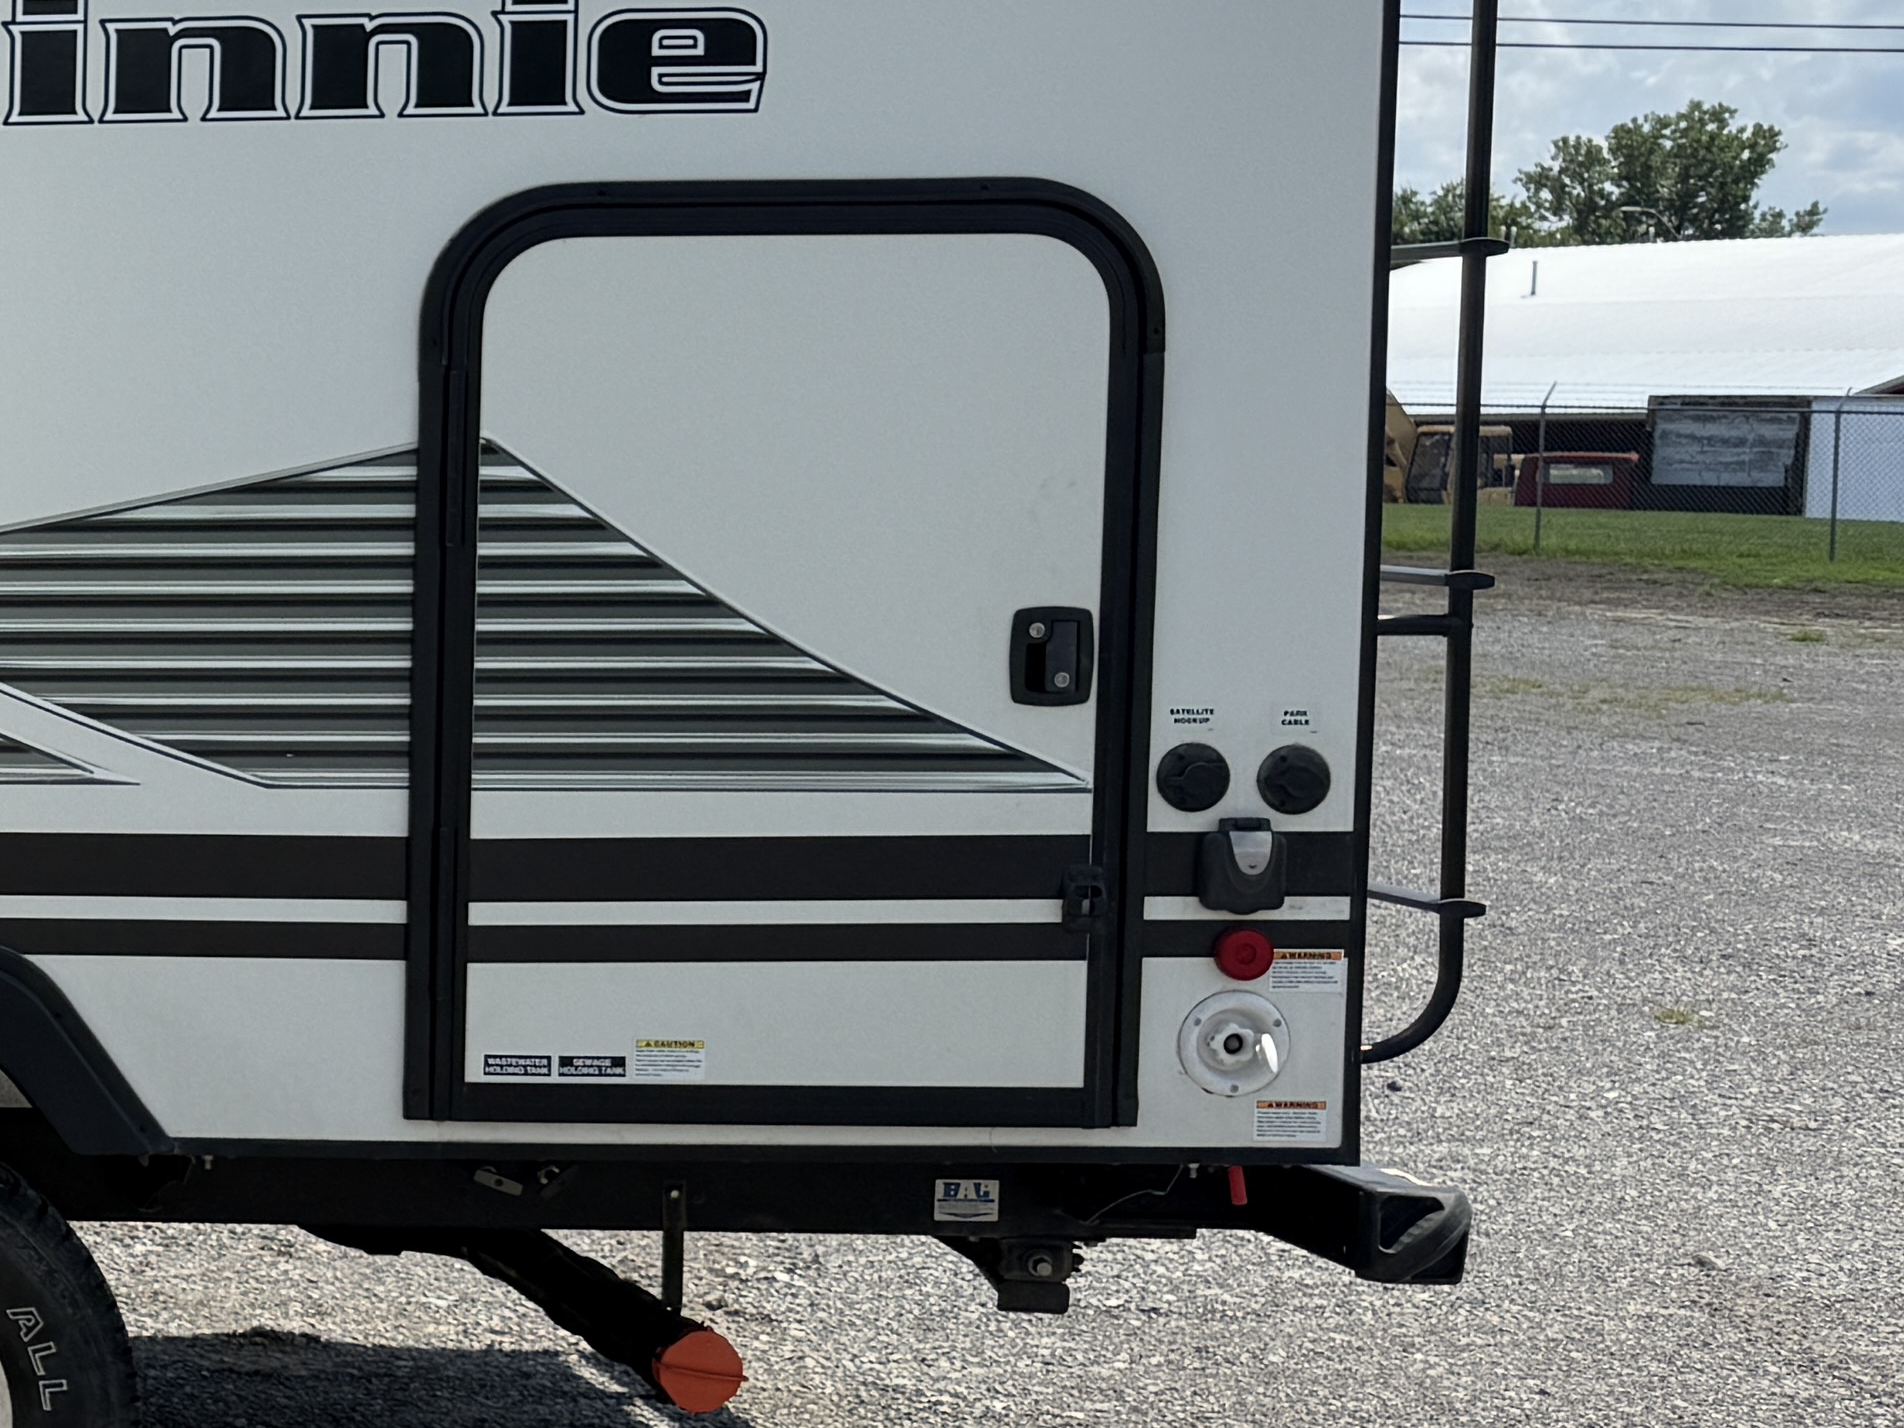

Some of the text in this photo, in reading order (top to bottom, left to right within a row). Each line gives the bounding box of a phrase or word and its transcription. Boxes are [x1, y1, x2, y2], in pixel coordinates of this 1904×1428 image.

[1169, 708, 1215, 716] SATELLITE
[654, 1040, 696, 1048] CAUTION
[487, 1058, 548, 1066] WASTEWATER
[572, 1058, 612, 1066] SEWAGE
[601, 1067, 625, 1075] TANK
[6, 1306, 68, 1411] ALL
